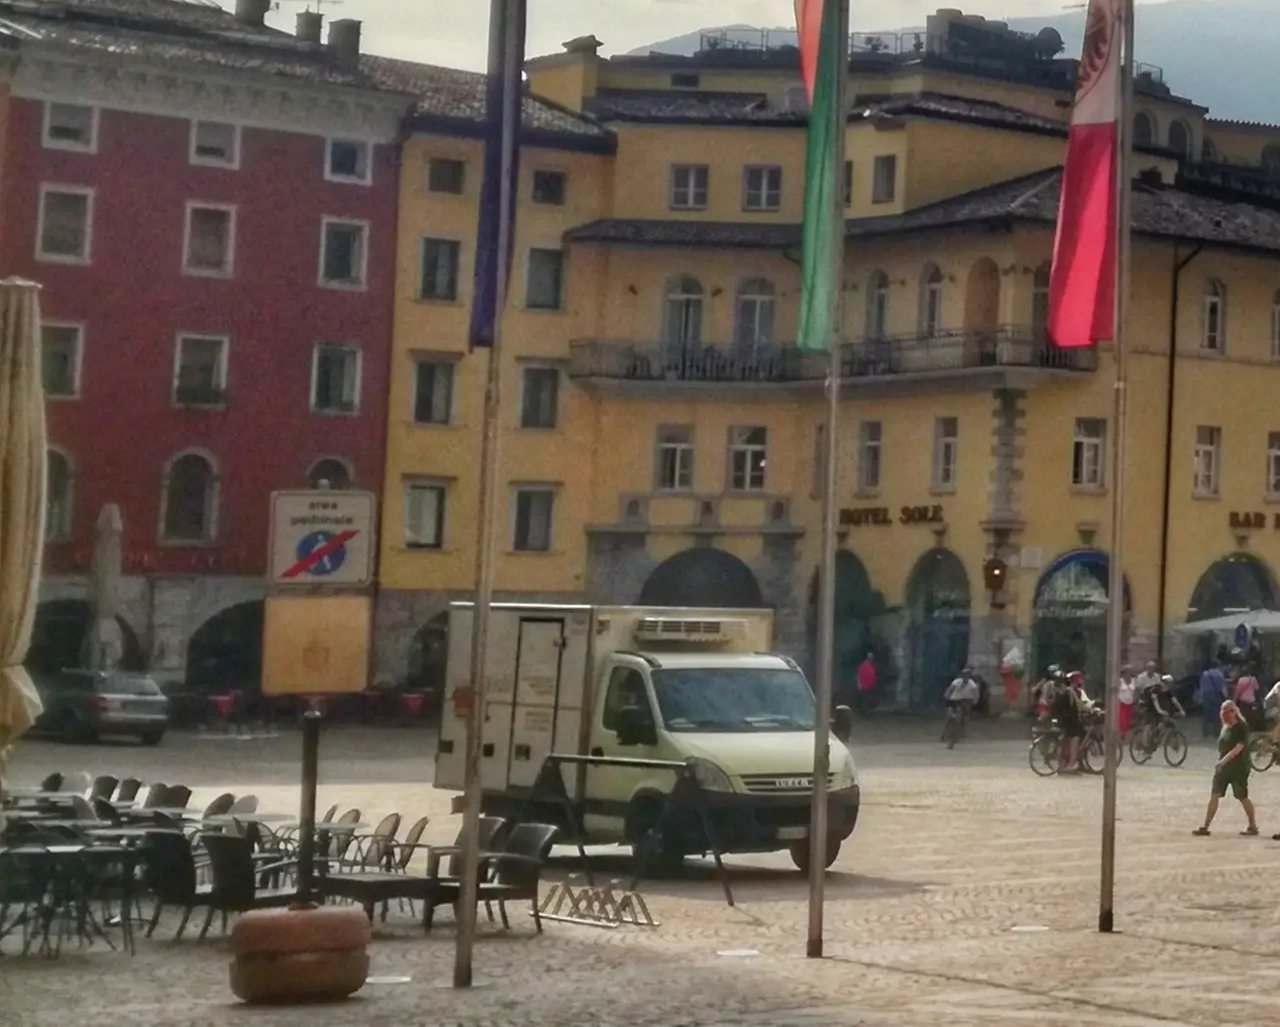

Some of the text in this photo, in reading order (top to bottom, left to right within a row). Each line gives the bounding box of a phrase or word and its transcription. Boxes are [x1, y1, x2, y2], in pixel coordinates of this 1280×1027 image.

[839, 505, 944, 527] HOTEL SOLE
[1229, 511, 1266, 528] BAR
